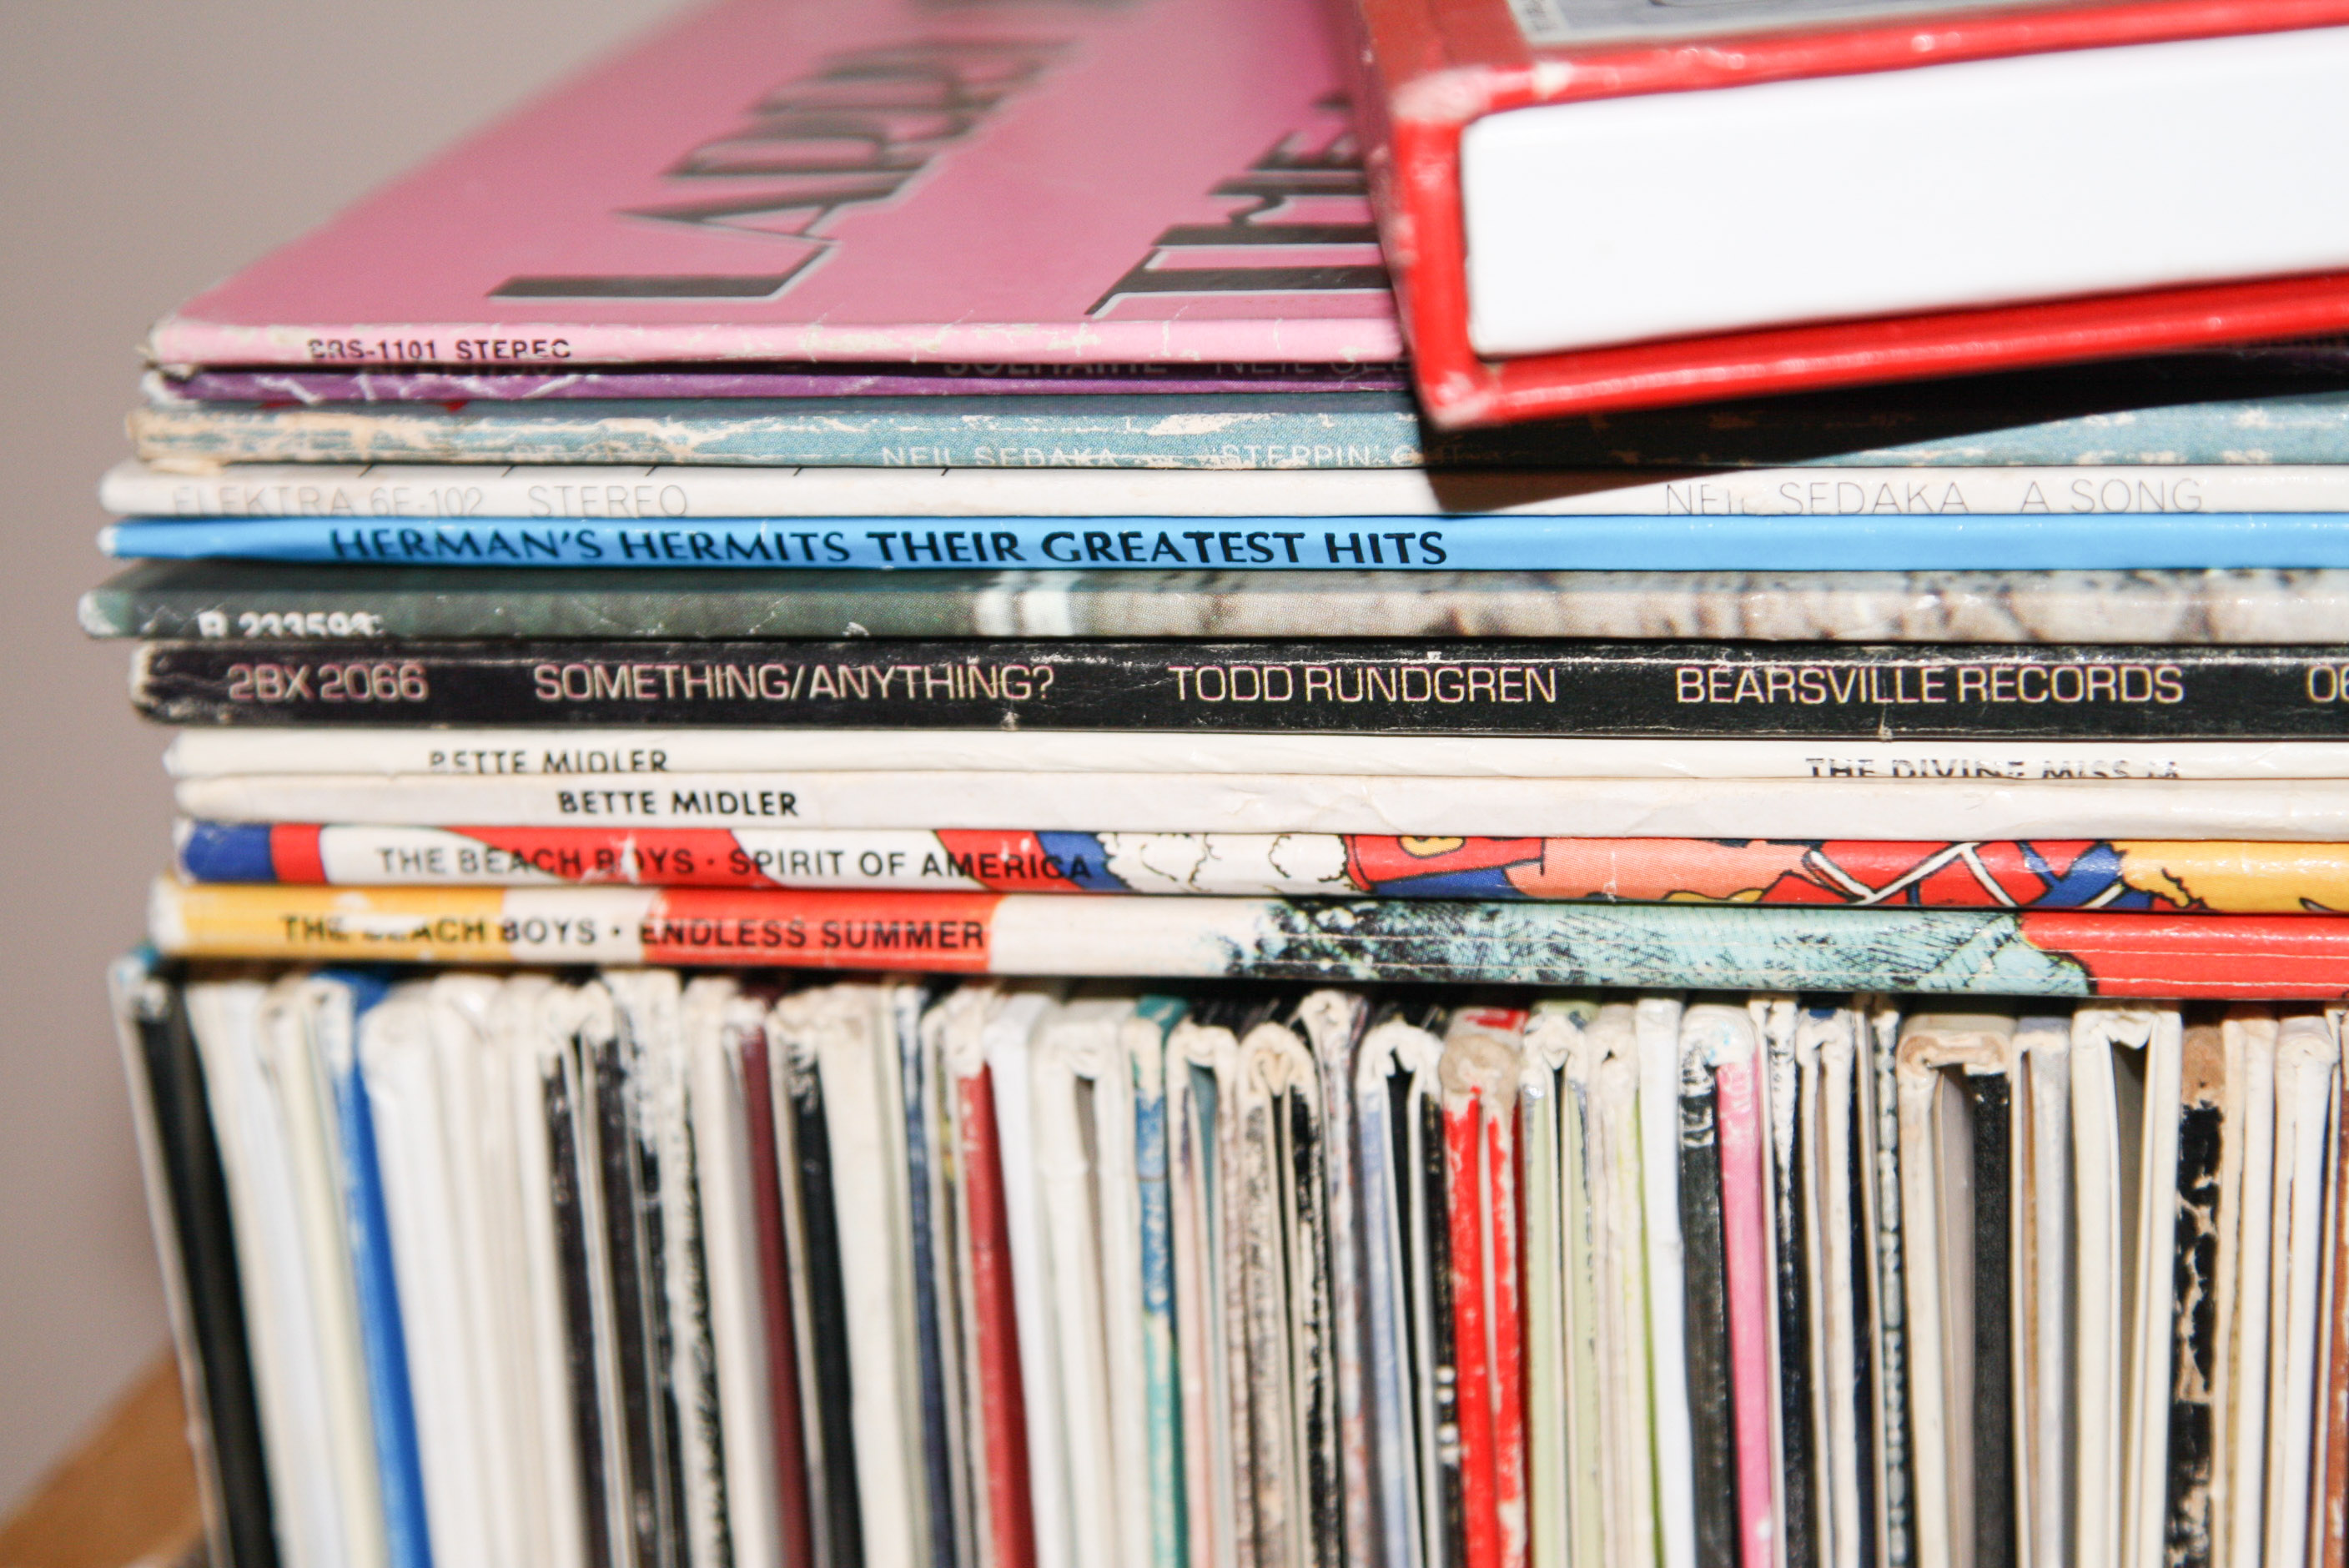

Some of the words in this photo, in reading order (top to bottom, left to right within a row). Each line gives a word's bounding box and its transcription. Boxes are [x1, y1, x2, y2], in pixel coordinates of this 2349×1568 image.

[882, 445, 960, 466] NEIL
[172, 486, 355, 517] ELEKTRA
[528, 485, 687, 517] STEREO
[1780, 481, 1969, 515] SEDAKA
[2020, 480, 2051, 514] A
[2070, 478, 2203, 514] SONG
[330, 528, 603, 560] HERMAN'S
[621, 530, 851, 563] HERMITS
[866, 530, 1026, 563] THEIR
[1041, 530, 1305, 564] GREATEST
[1325, 531, 1448, 565] HITS
[228, 664, 315, 701] 2BX
[318, 664, 429, 702] 2066
[534, 664, 1054, 701] SOMETHING/ANYTHING?
[1168, 666, 1294, 702] TODD
[1305, 666, 1557, 704] RUNDGREN
[1676, 666, 1947, 705] BEARSVILLE
[1959, 665, 2185, 705] RECORDS
[543, 749, 667, 774] MIDLER
[558, 791, 656, 817] BETTE
[671, 791, 798, 817] MIDLER
[379, 847, 447, 873] THE
[458, 847, 582, 875] BEACH
[729, 849, 846, 877] SPIRIT
[858, 852, 907, 877] OF
[920, 852, 1094, 881] AMERICA
[501, 917, 598, 945] BOYS
[639, 918, 807, 948] ENDLESS
[820, 920, 985, 949] SUMMER
